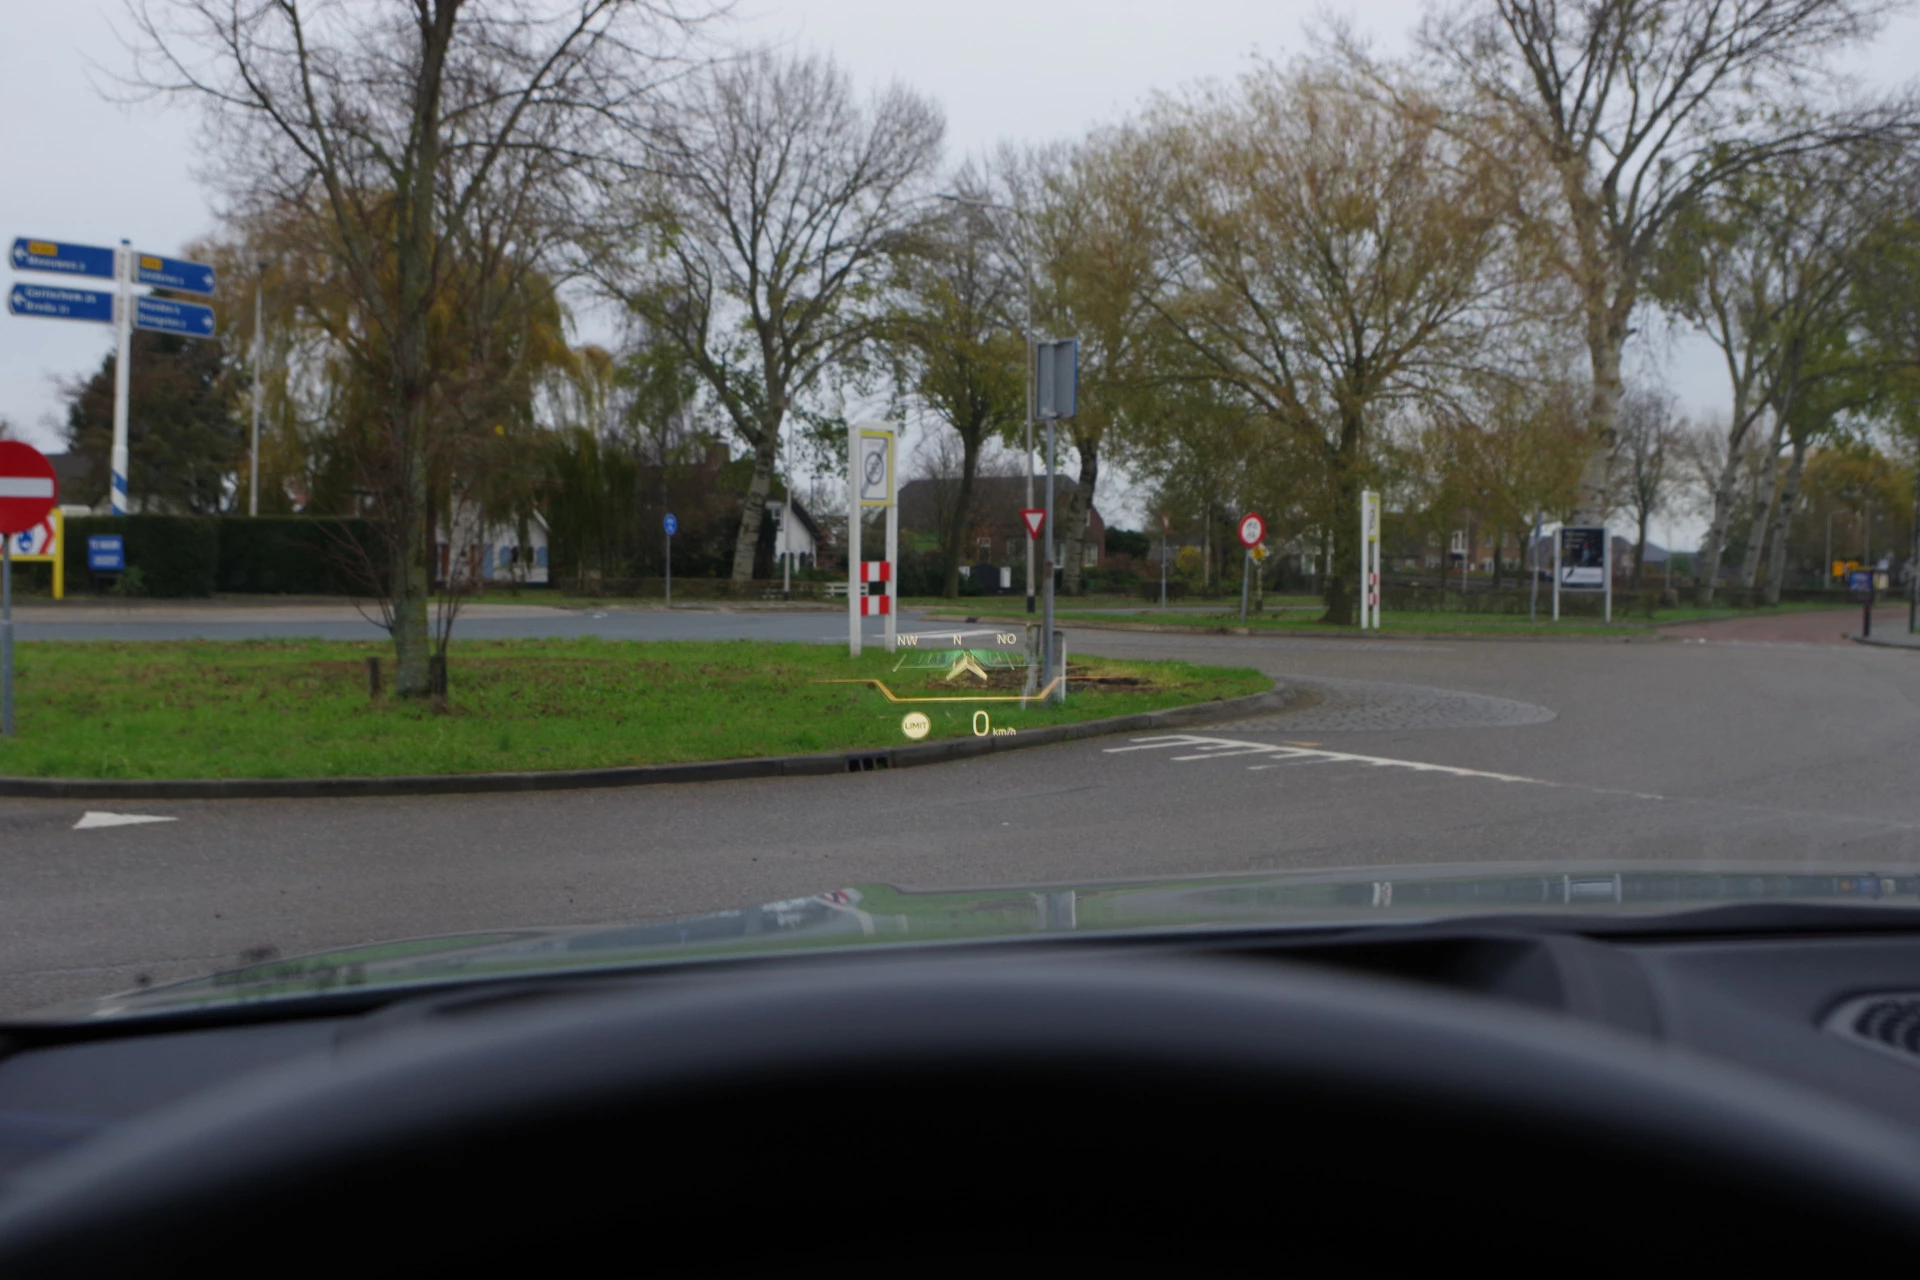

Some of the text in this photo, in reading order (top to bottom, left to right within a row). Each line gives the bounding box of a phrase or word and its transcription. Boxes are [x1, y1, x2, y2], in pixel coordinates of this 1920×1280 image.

[897, 633, 1017, 645] NW N NO
[905, 722, 927, 730] LIMIT
[973, 710, 1017, 737] 0 km/h
